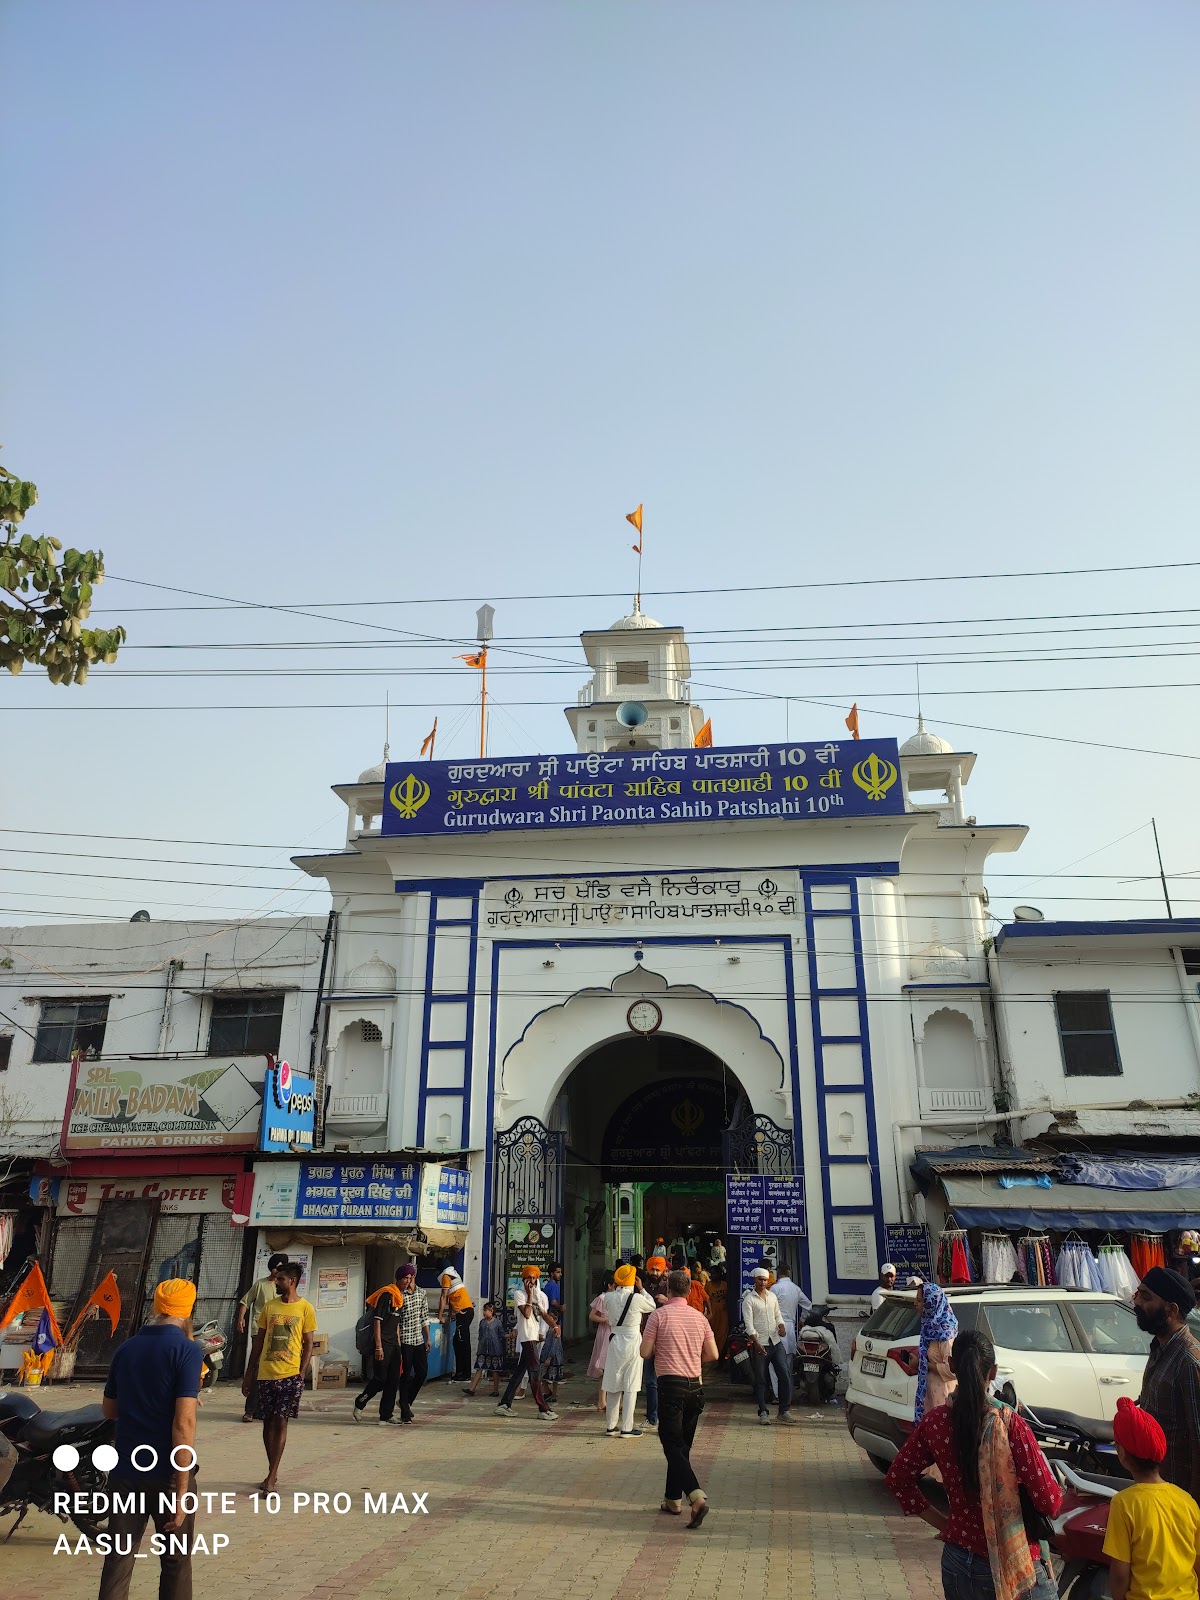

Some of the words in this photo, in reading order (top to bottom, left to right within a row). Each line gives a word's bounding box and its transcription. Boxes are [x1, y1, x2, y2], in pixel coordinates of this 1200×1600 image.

[447, 762, 531, 783] ਗੁਰਦੁਆਰਾ
[631, 751, 687, 772] ਸਾਹਿਬ
[777, 748, 807, 766] 10
[814, 743, 841, 764] ਵੀਂ
[447, 787, 518, 809] गुरुद्वारा
[528, 781, 550, 800] श्री
[559, 780, 614, 799] पांवटा
[623, 776, 682, 797] साहिब
[692, 771, 773, 794] पातशाही
[783, 775, 809, 792] 10
[819, 768, 843, 788] वीं
[444, 808, 545, 827] Gurudwara
[549, 805, 587, 823] Shri
[591, 804, 655, 821] Paonta
[660, 801, 712, 819] Sahib
[717, 797, 801, 816] Patshahi
[806, 793, 844, 813] 10th
[534, 886, 566, 899] ਸਚ
[631, 900, 679, 919] ਸਾਹਿਬ
[86, 1067, 117, 1084] SPL.
[73, 1085, 123, 1118] MILK
[125, 1084, 201, 1118] BADAM
[290, 1092, 314, 1114] pepsi
[70, 1123, 88, 1133] ICE
[100, 1136, 157, 1147] PAHWA
[162, 1135, 224, 1146] DRINKS
[305, 1186, 338, 1198] भगत
[368, 1182, 394, 1200] सिंह
[394, 1182, 413, 1199] जी
[302, 1205, 339, 1217] BHAGAT
[340, 1205, 373, 1217] PURAN
[374, 1205, 403, 1217] SINGH
